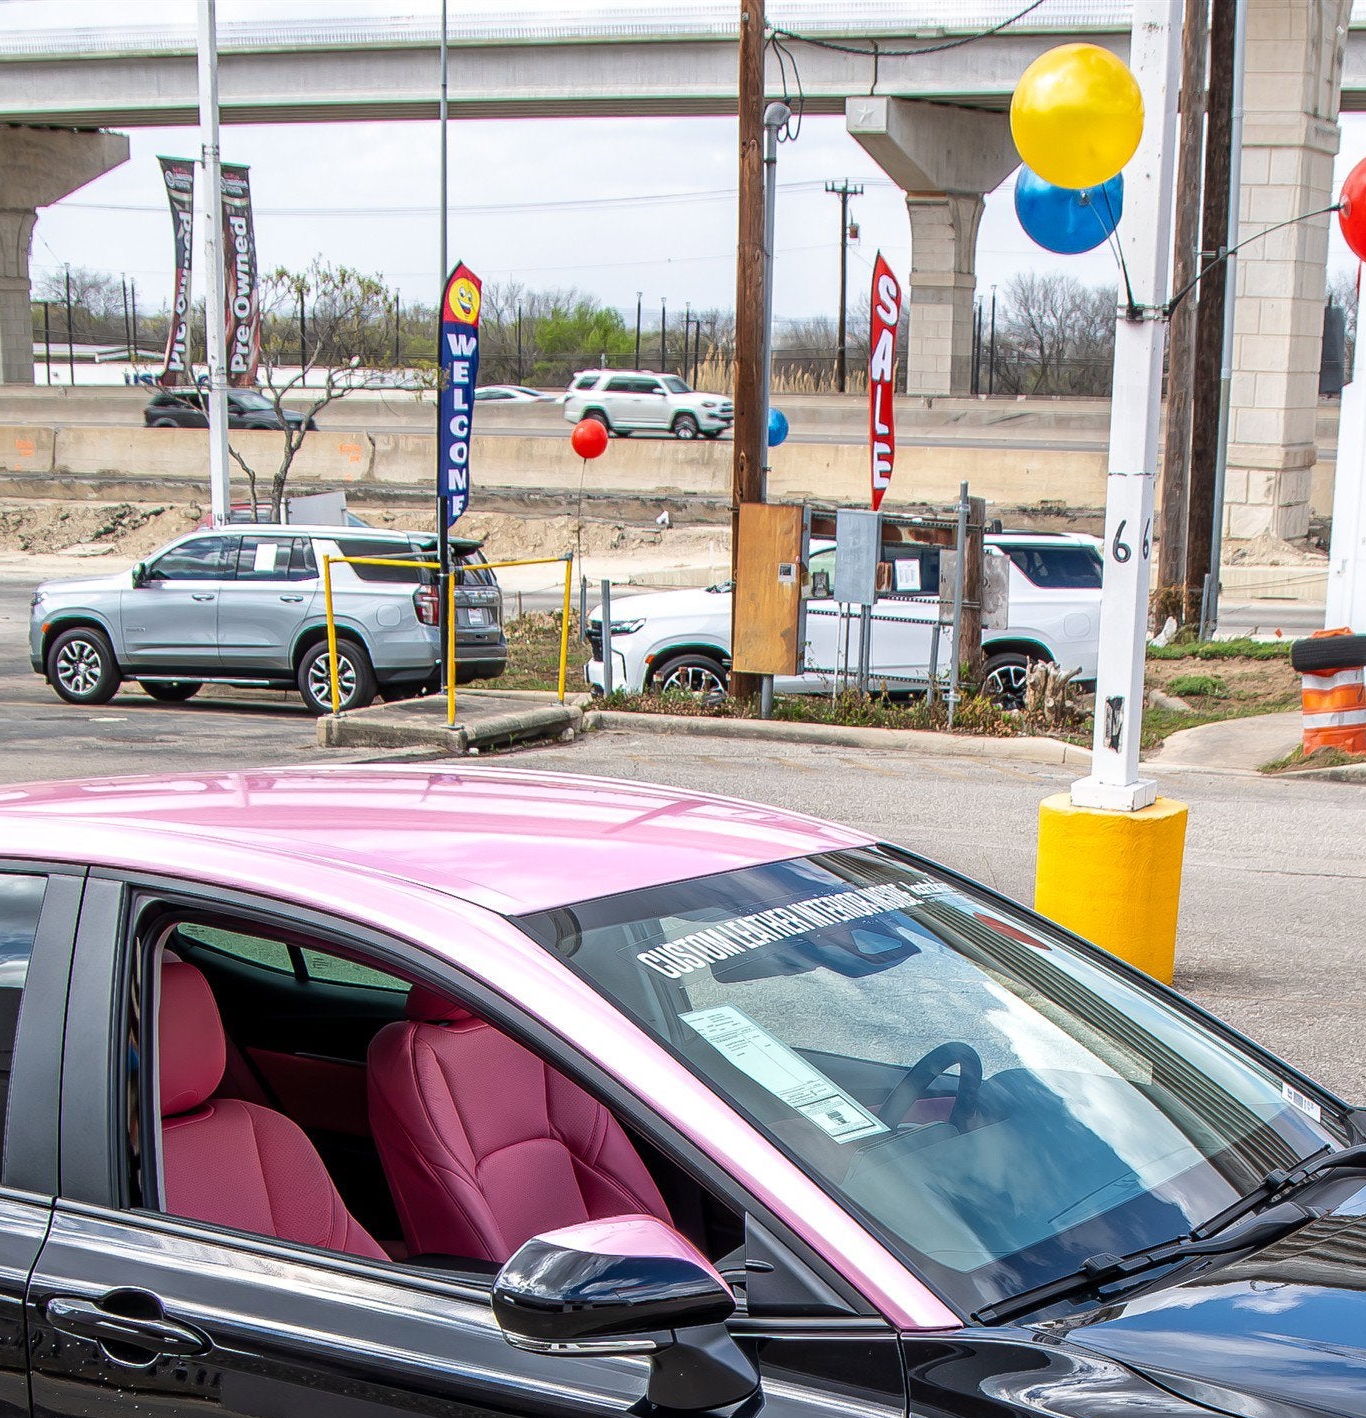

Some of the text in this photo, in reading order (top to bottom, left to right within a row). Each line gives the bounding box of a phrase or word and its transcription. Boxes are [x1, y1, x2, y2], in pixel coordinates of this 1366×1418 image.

[446, 333, 477, 517] WELCOME
[872, 274, 898, 490] SALE
[1112, 519, 1131, 563] 6
[1143, 518, 1150, 560] 6
[637, 925, 747, 979] CUSTOM
[724, 907, 809, 950] LEATHER
[786, 891, 886, 931] INTERIOR
